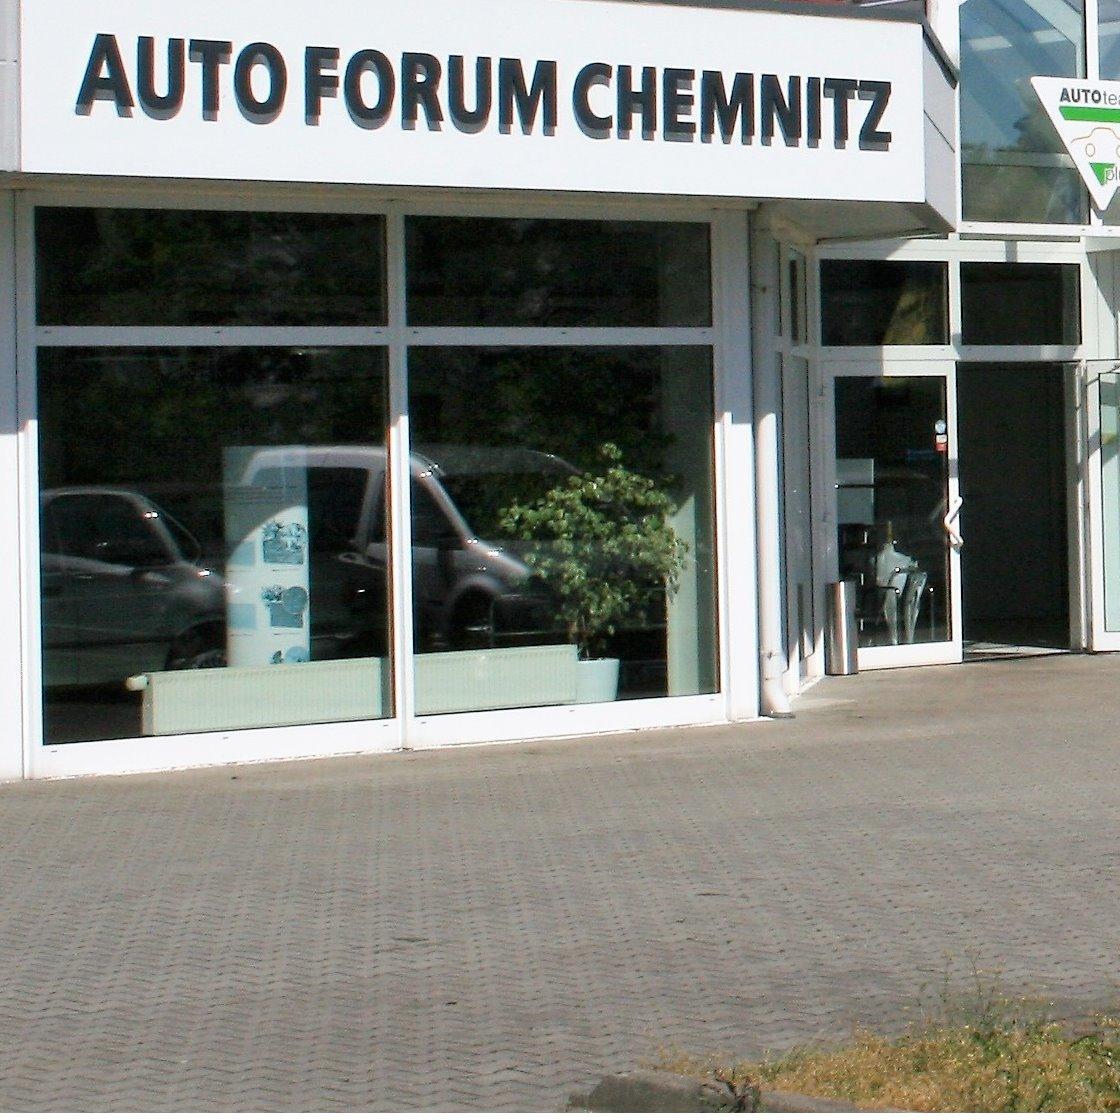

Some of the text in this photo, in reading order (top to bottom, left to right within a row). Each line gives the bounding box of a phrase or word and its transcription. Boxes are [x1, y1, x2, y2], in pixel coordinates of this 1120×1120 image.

[75, 33, 892, 152] AUTO FORUM CHEMNITZ
